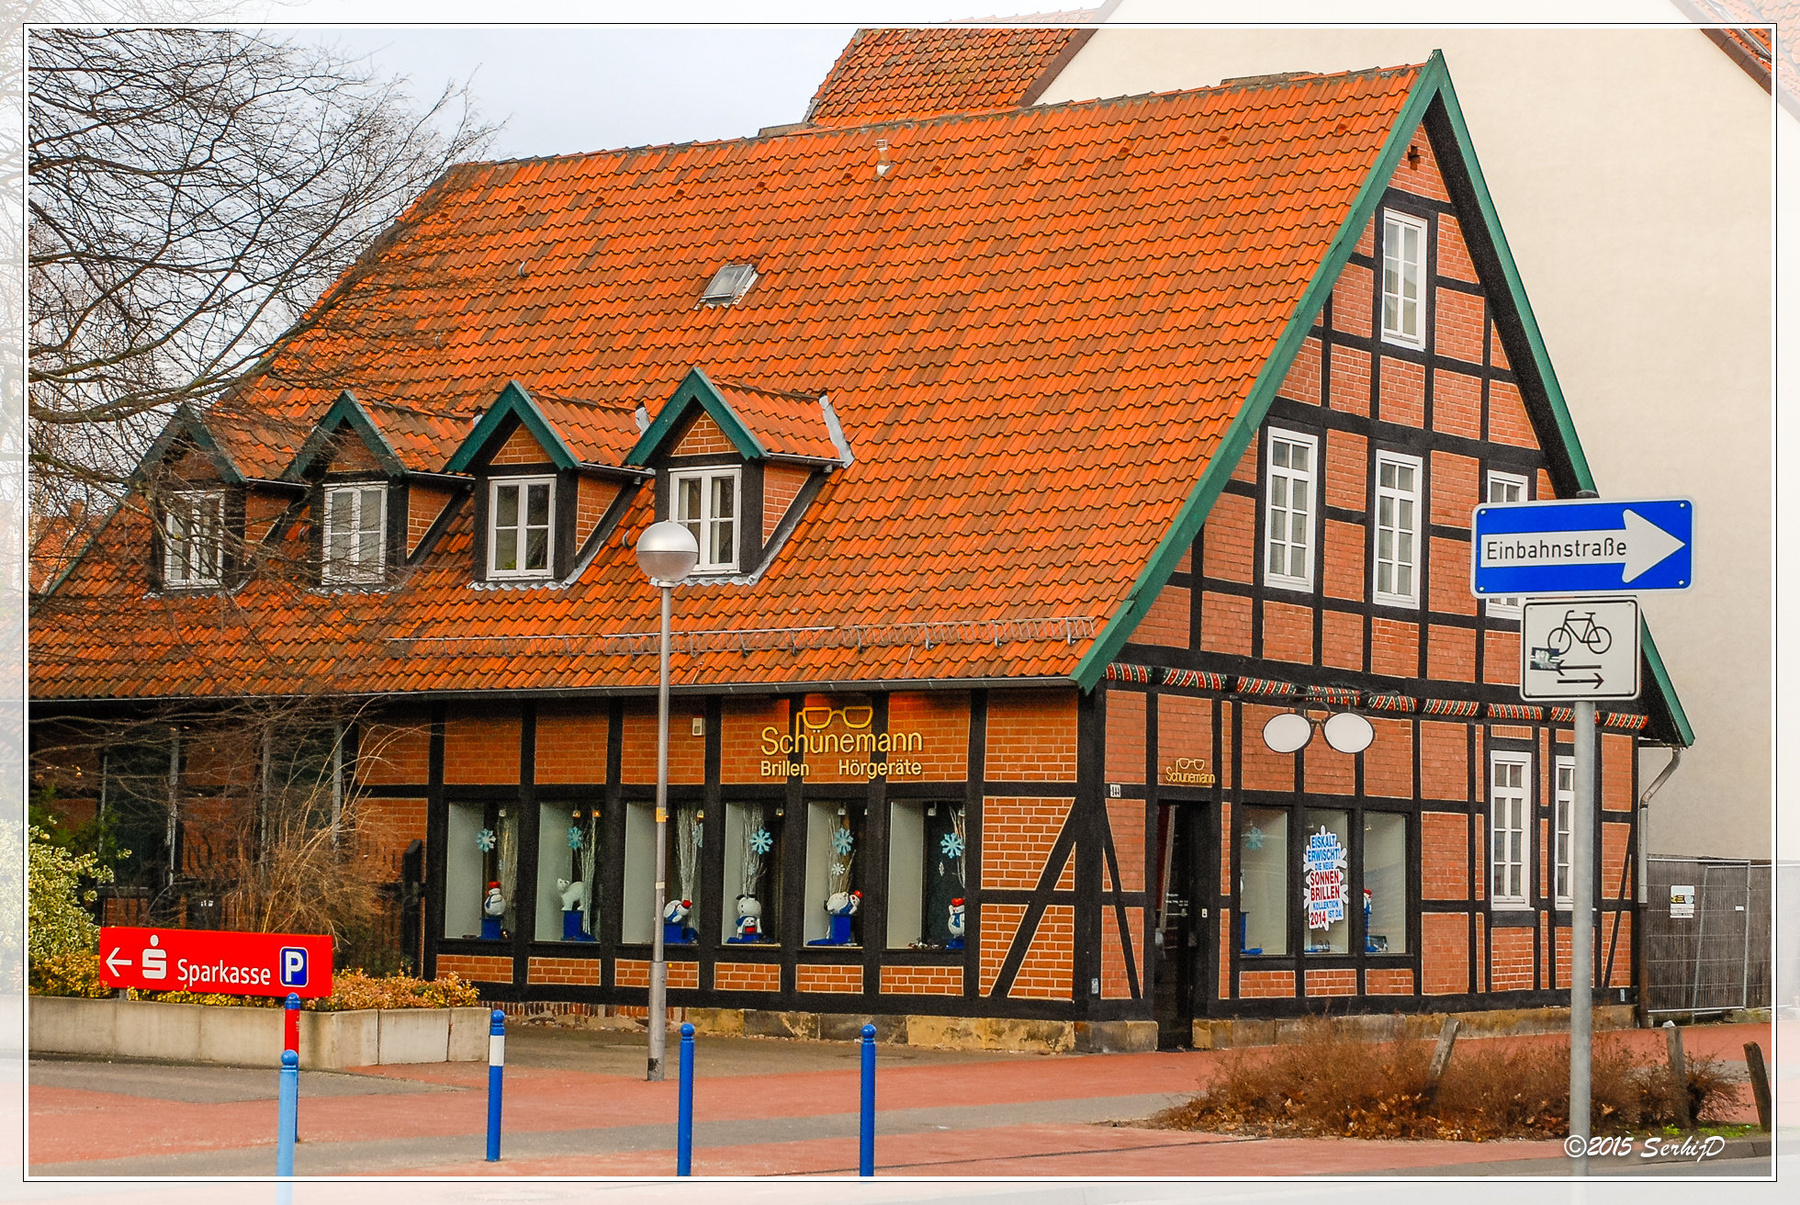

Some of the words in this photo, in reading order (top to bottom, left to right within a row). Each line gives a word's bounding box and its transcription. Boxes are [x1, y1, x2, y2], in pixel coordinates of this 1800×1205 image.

[1486, 537, 1627, 560] Einbahnstraße
[761, 712, 923, 755] Schünemann
[760, 760, 810, 776] Brillen
[838, 758, 922, 780] Hörgeräte
[1311, 835, 1336, 849] EISKALT
[1310, 869, 1340, 886] SONNEN
[1310, 886, 1341, 901] BRILLEN
[1310, 911, 1327, 926] 2014
[177, 958, 271, 987] Sparkasse
[285, 951, 304, 983] P
